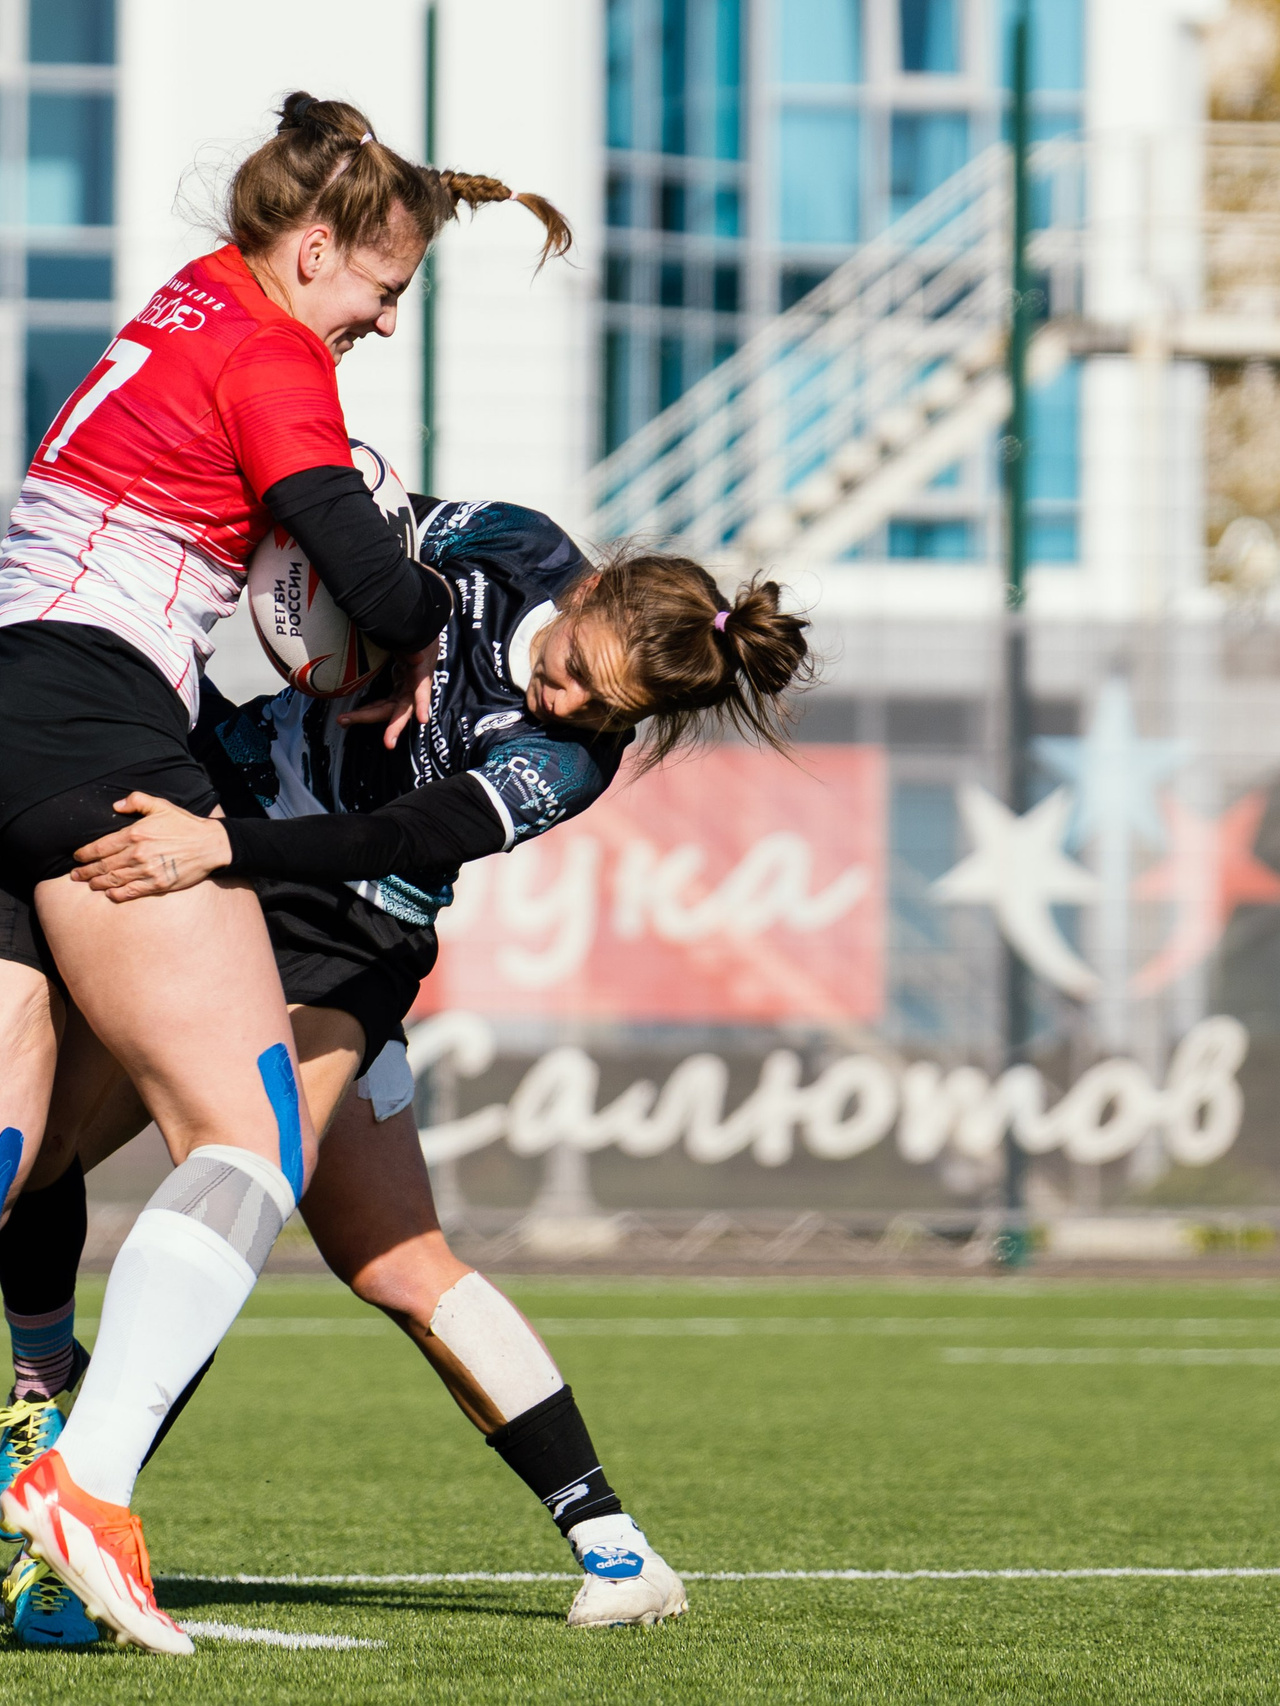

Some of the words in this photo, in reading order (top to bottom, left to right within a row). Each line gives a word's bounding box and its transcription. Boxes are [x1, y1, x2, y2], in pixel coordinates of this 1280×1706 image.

[41, 337, 153, 463] 7
[274, 578, 287, 636] РЕГБИ
[287, 561, 303, 638] РОССИИ
[596, 1556, 637, 1570] adidas
